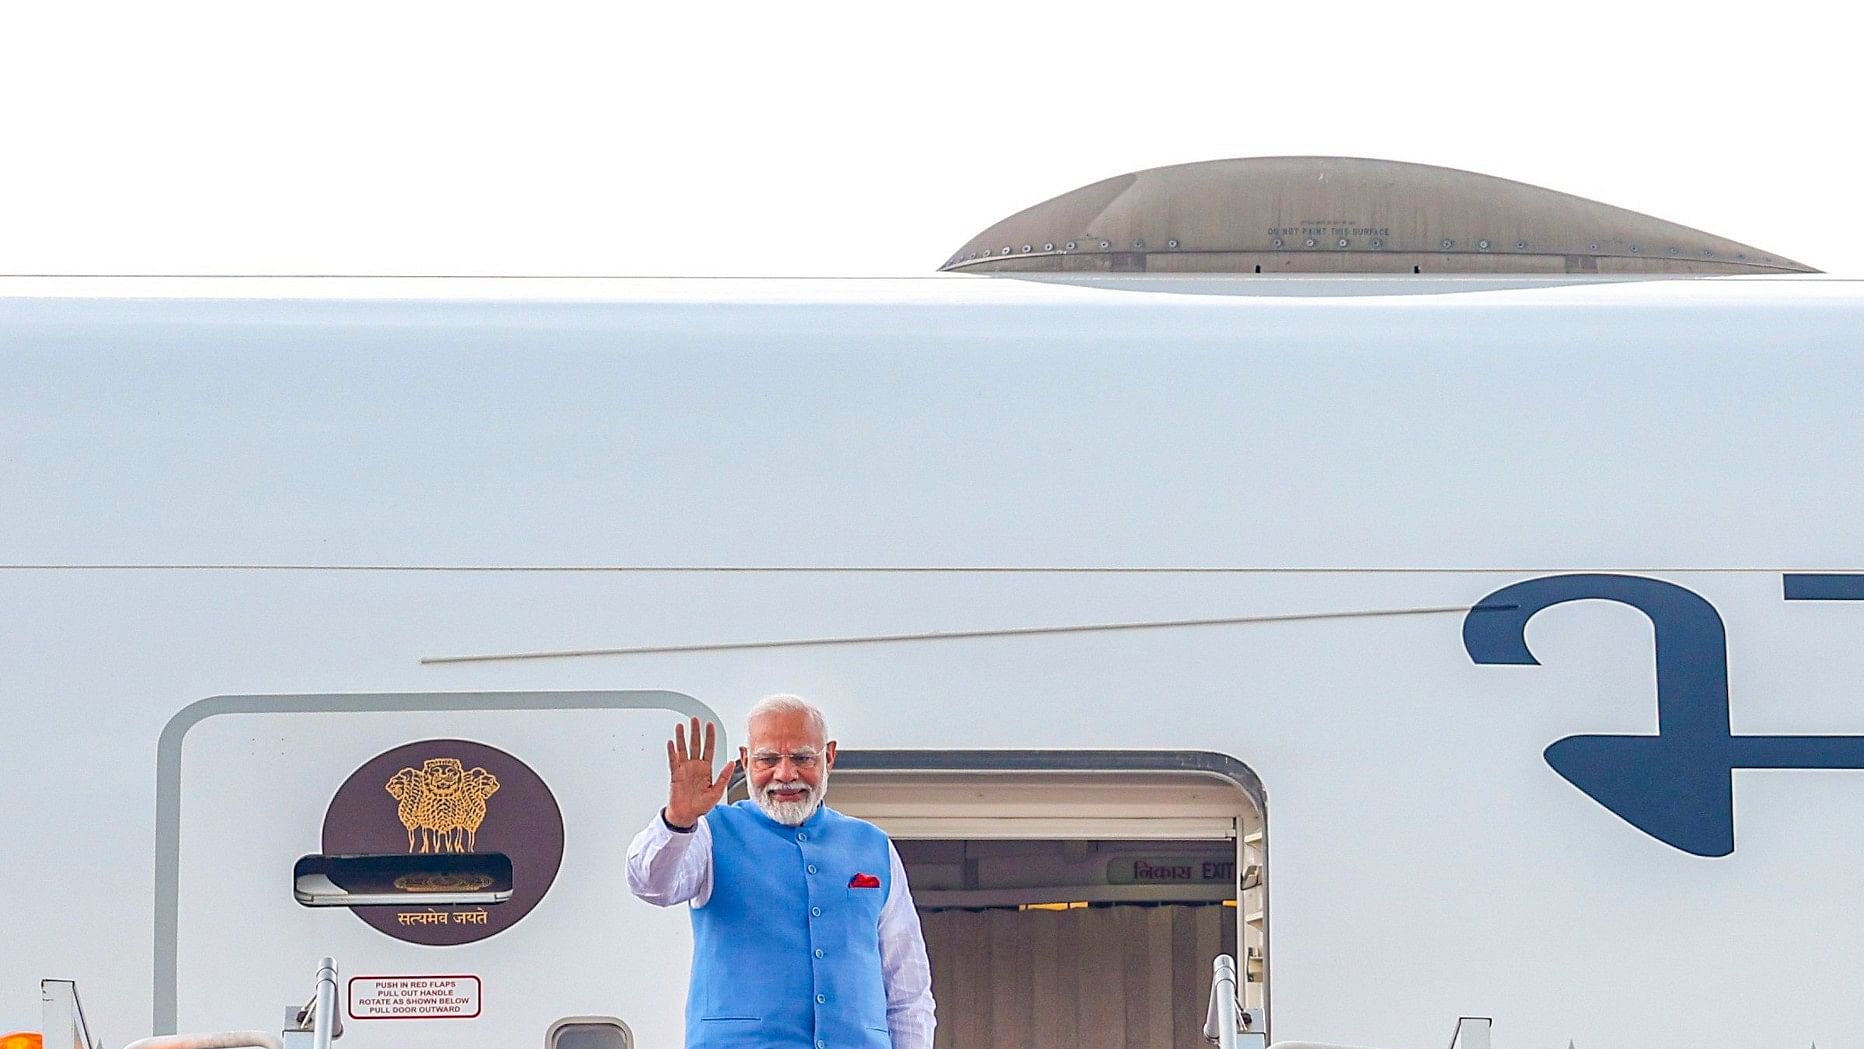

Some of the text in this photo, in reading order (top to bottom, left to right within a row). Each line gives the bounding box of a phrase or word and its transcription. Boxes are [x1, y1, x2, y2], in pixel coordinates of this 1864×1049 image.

[1203, 862, 1234, 879] EXIT
[398, 907, 489, 925] सत्यमेव जयते
[375, 981, 398, 989] PUSH
[399, 981, 408, 989] IN
[410, 981, 428, 989] RED
[420, 989, 454, 997] HANDLE
[359, 998, 391, 1006] ROTATE
[369, 1006, 390, 1014] PULL
[419, 1005, 461, 1013] OUTWARD
